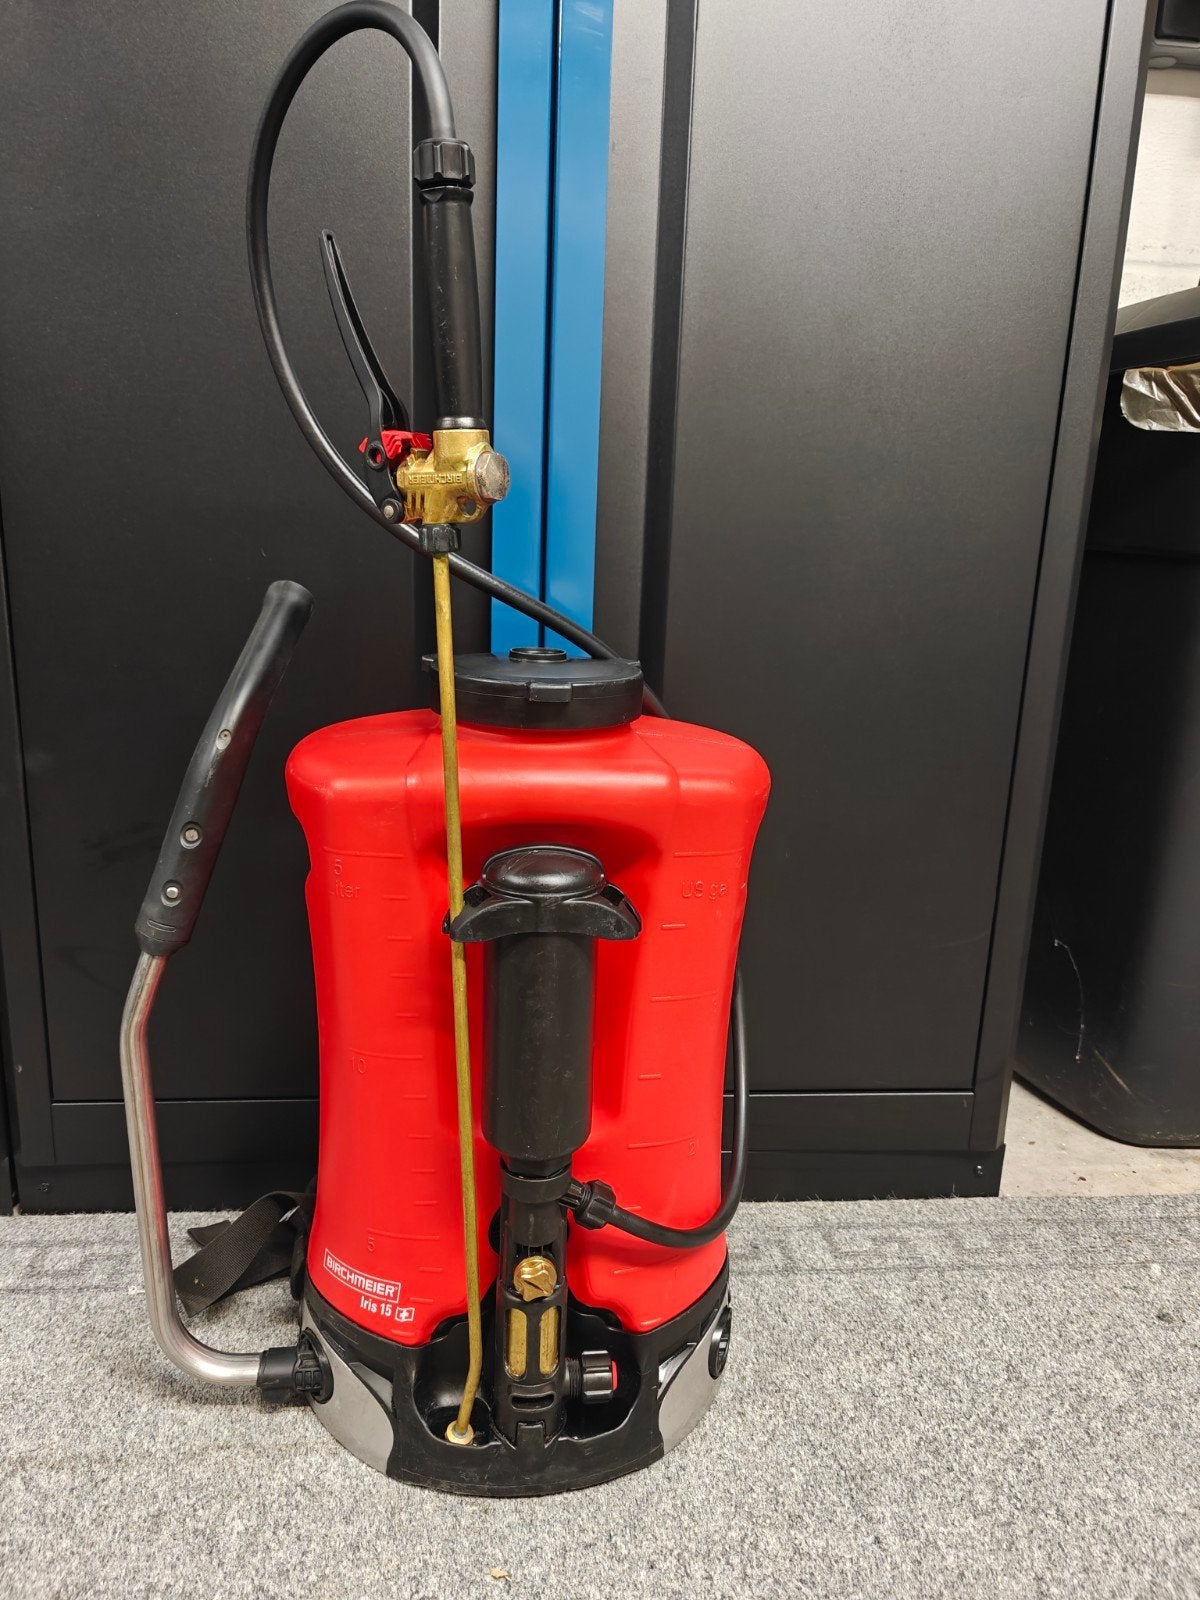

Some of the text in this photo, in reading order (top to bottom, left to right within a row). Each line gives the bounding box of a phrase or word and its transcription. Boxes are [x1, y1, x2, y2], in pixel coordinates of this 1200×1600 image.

[682, 880, 704, 897] US
[367, 1237, 376, 1253] 5
[326, 1255, 395, 1298] BIRCHMEIER
[360, 1295, 393, 1317] Iris 15
